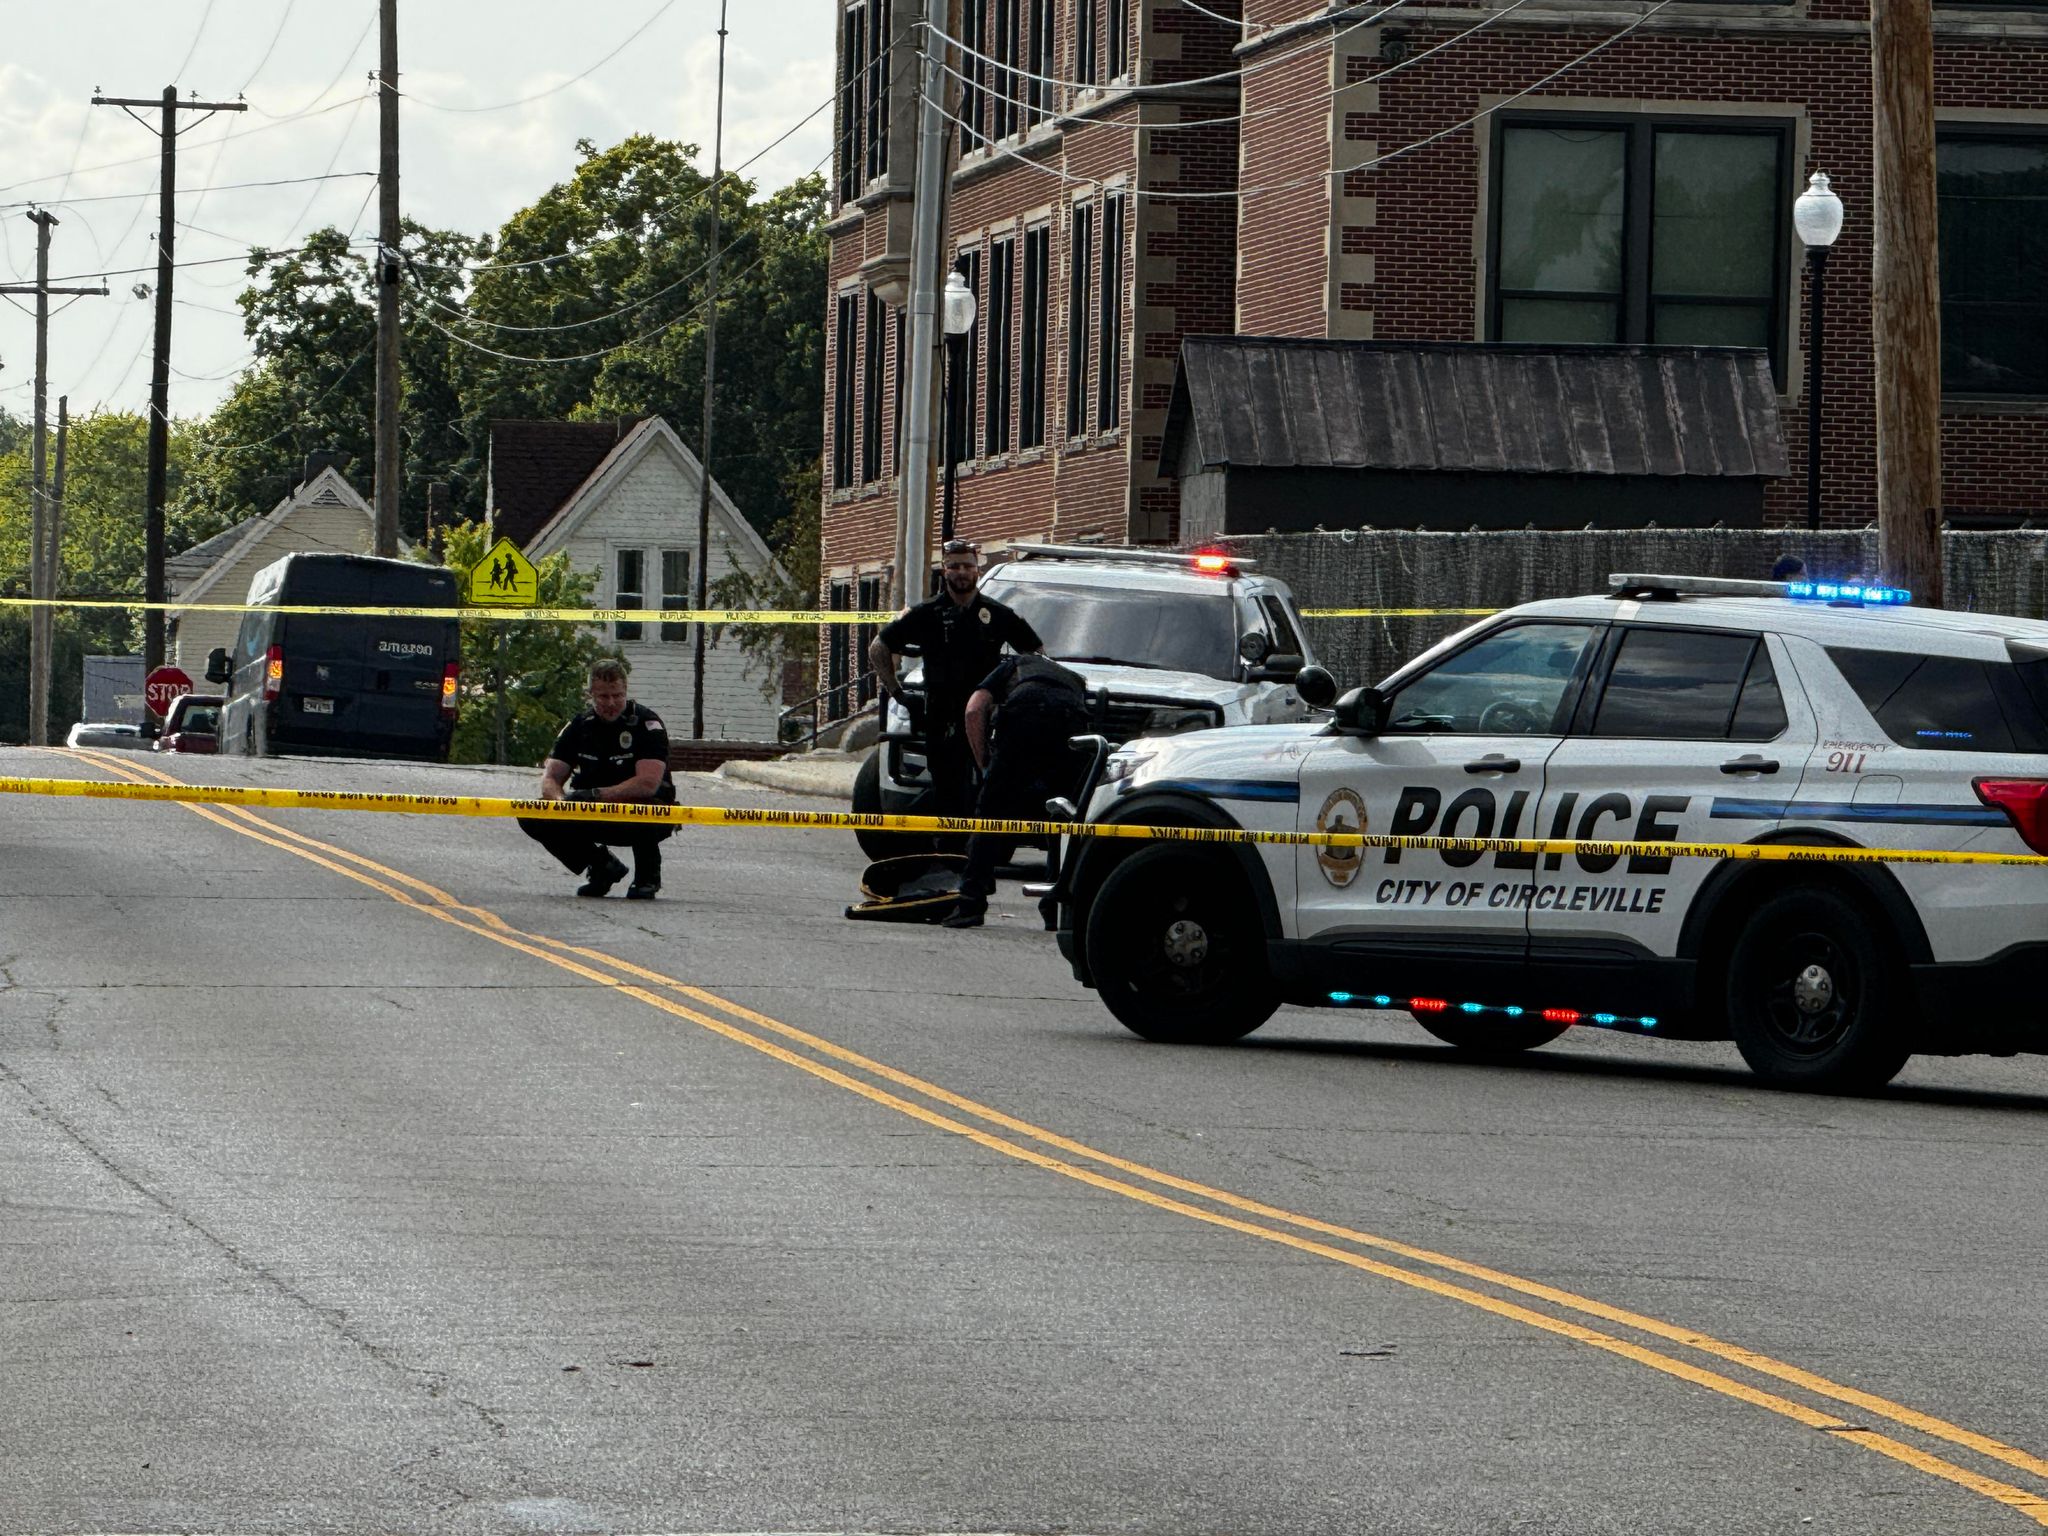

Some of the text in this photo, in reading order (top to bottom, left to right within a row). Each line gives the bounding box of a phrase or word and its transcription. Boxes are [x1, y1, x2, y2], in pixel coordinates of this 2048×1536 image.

[378, 641, 433, 656] amazon
[148, 683, 191, 701] STOP
[1826, 752, 1866, 774] 911
[1384, 786, 1692, 875] POLICE
[1376, 879, 1665, 914] CITY OF CIRCLEVILLE
